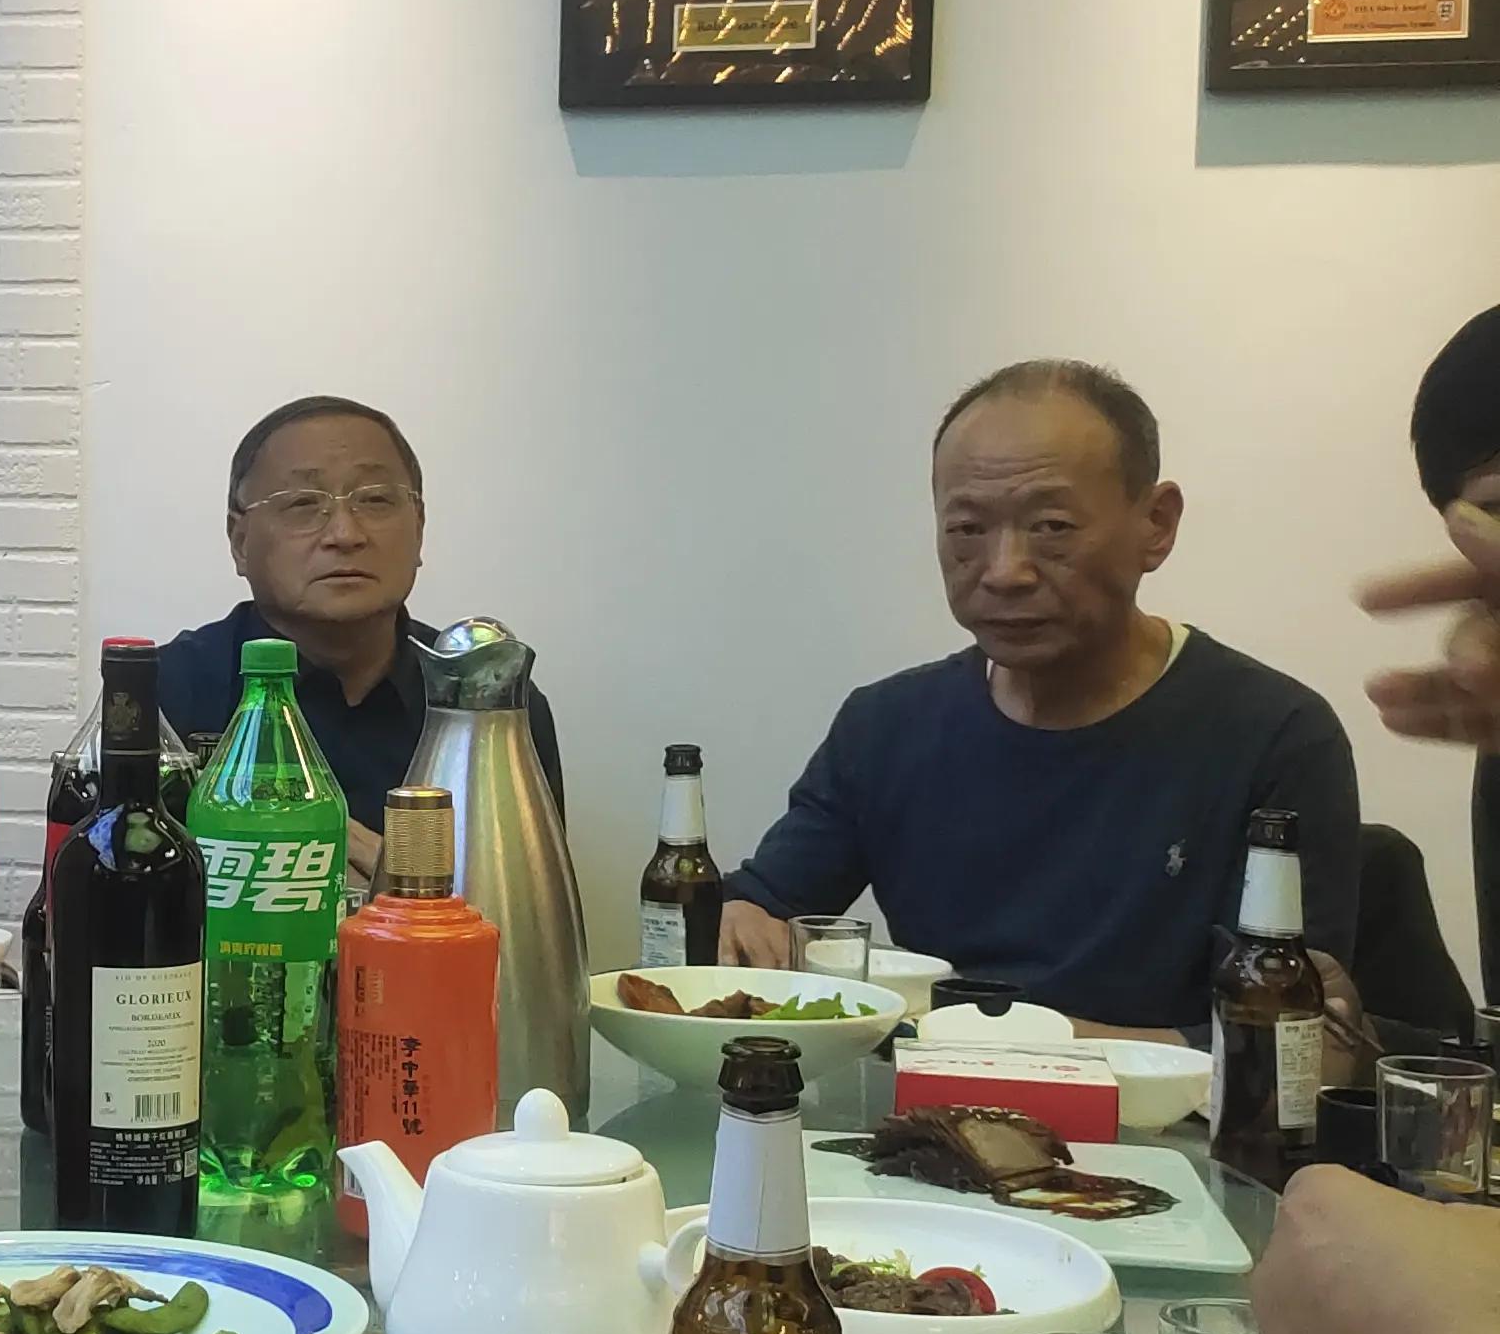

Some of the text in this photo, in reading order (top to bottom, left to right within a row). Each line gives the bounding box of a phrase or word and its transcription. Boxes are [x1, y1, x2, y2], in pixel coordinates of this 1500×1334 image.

[196, 837, 336, 912] 雪碧
[116, 990, 192, 1005] GLORIEUX
[131, 1011, 181, 1022] BORDEAUX
